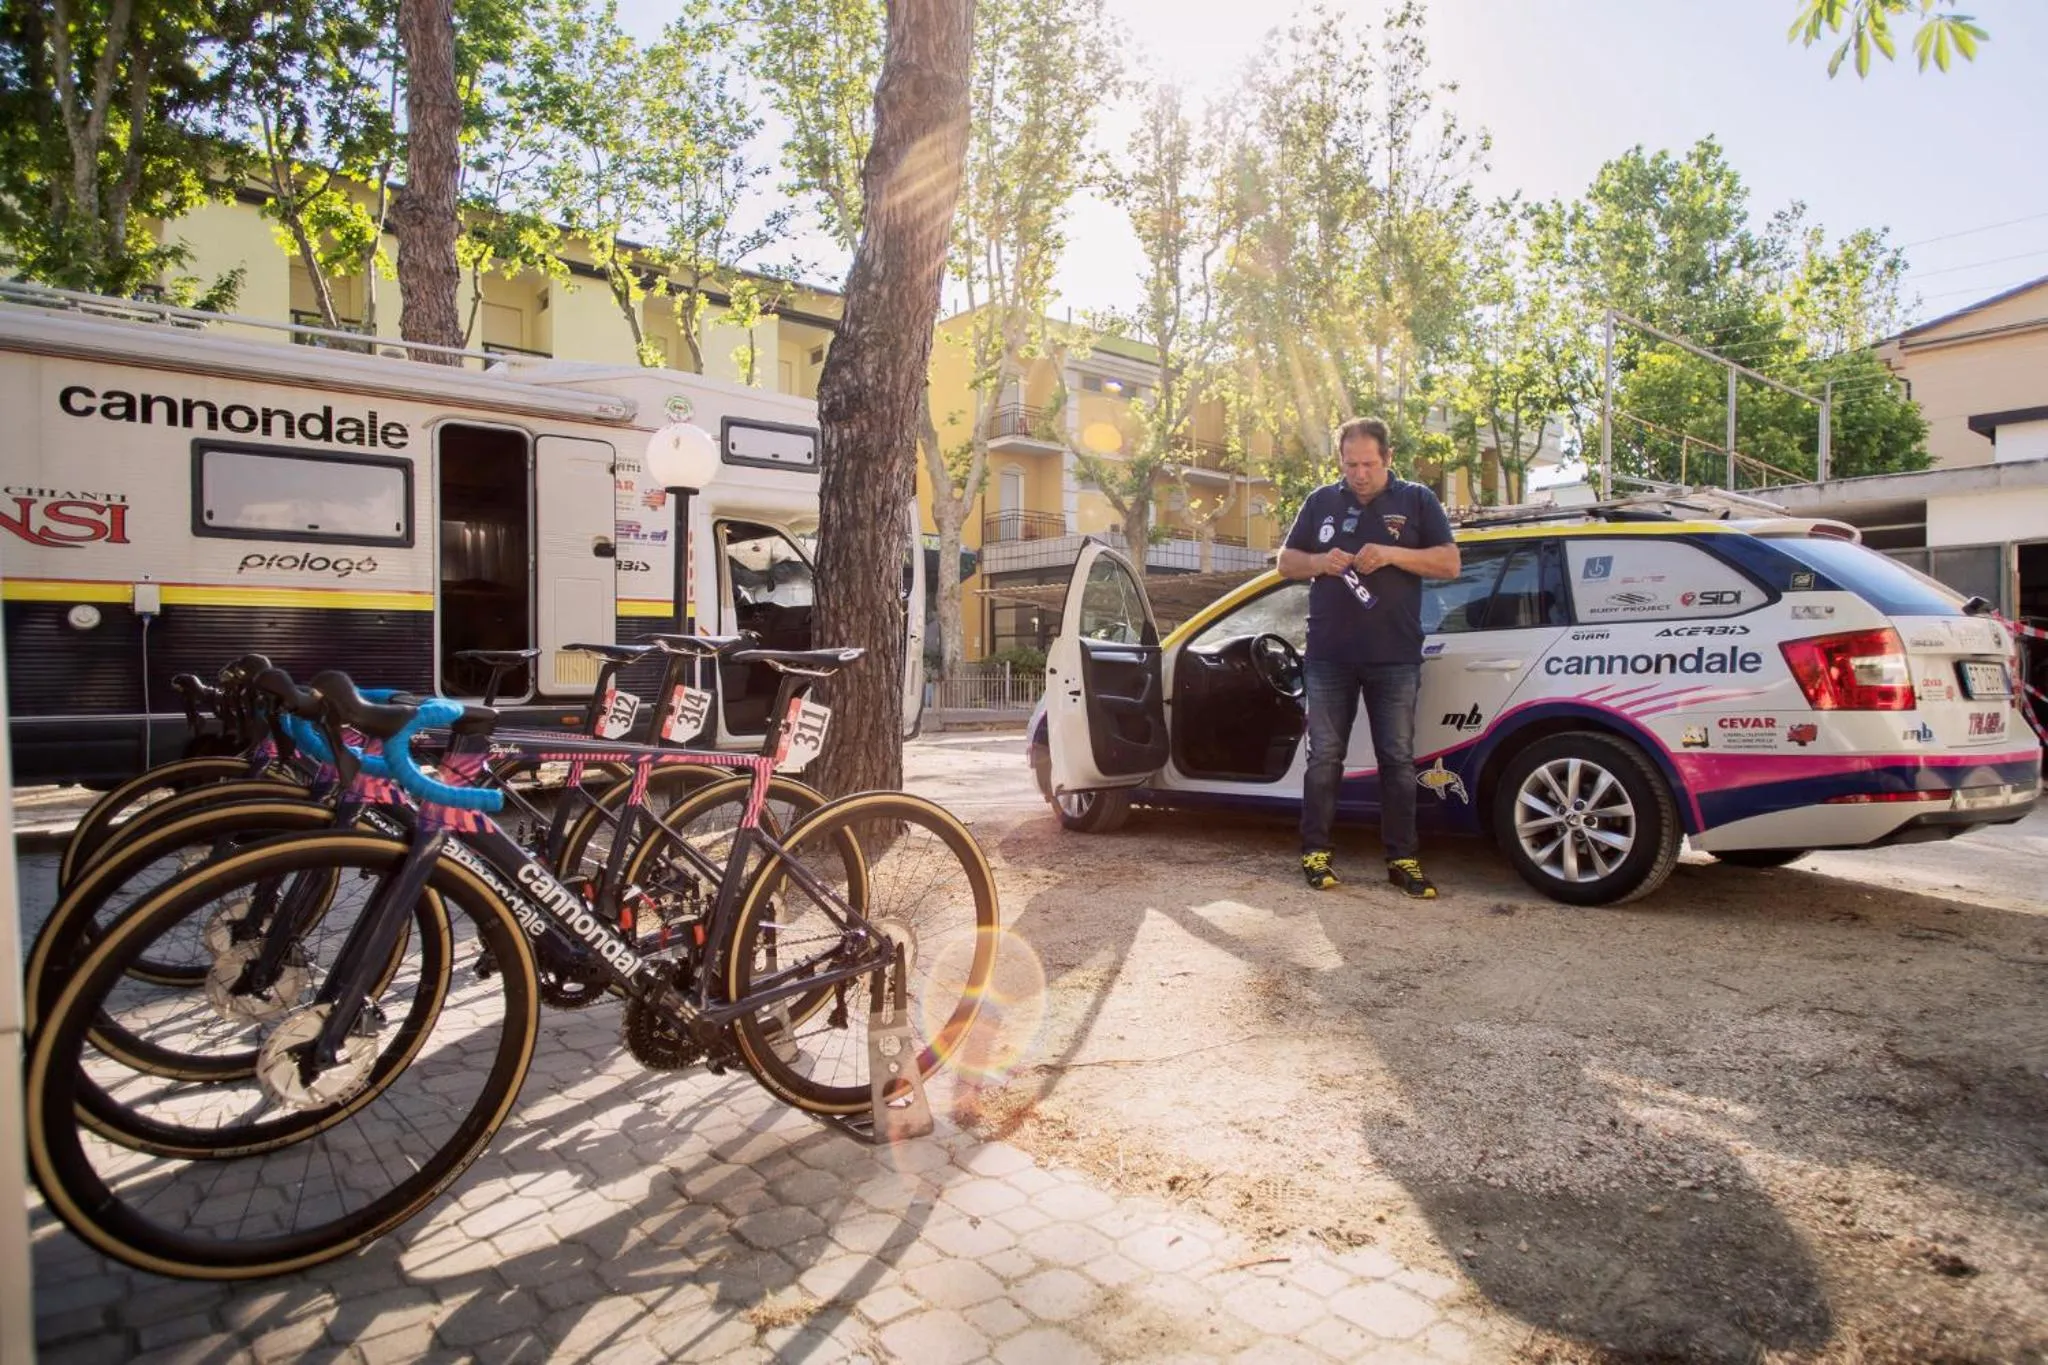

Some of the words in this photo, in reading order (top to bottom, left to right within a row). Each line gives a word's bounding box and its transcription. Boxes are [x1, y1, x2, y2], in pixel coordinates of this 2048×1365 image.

[59, 385, 409, 449] cannondale
[4, 486, 126, 502] CHIANTI
[237, 552, 379, 578] prologo
[1544, 645, 1763, 677] cannondale
[608, 695, 637, 728] 312
[677, 693, 708, 729] 314
[1718, 717, 1776, 729] CEVAR
[793, 709, 828, 751] 311
[517, 862, 643, 980] cannondal
